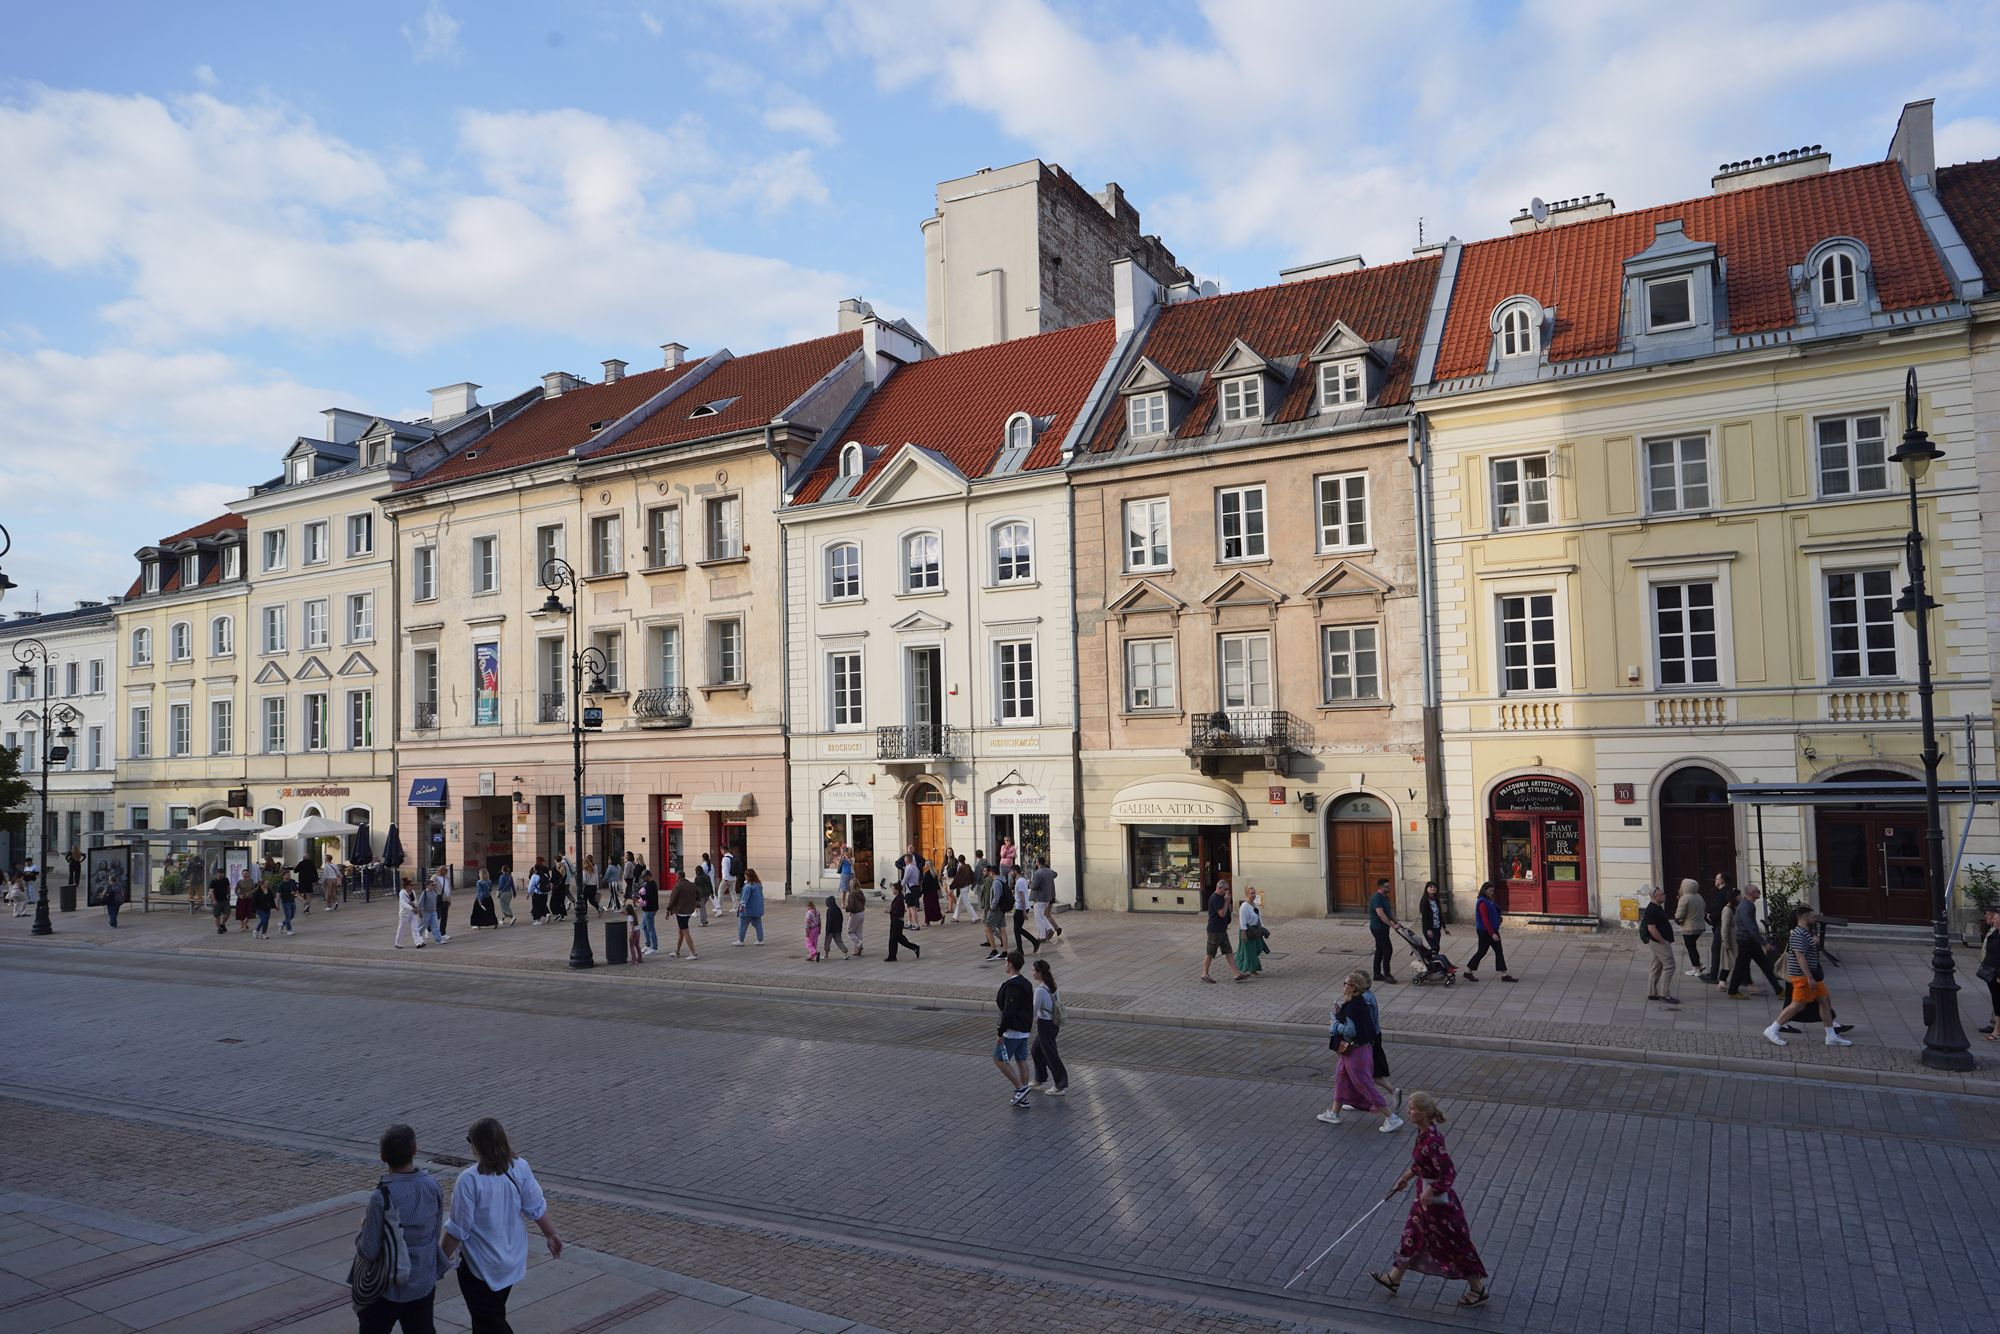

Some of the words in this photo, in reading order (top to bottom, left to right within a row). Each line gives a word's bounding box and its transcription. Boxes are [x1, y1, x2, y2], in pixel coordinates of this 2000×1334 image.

[1499, 781, 1529, 796] PRACOWNIA
[1531, 780, 1575, 797] ARTYSTYCZNYCH
[1513, 788, 1526, 796] RAM
[1527, 787, 1559, 796] STYLOWYCH
[1273, 791, 1281, 800] 12
[1618, 789, 1629, 799] 10
[1119, 803, 1163, 814] GALERIA
[1166, 803, 1215, 814] ATTICUS
[1351, 802, 1371, 813] 12
[1545, 831, 1579, 839] STYLOWE
